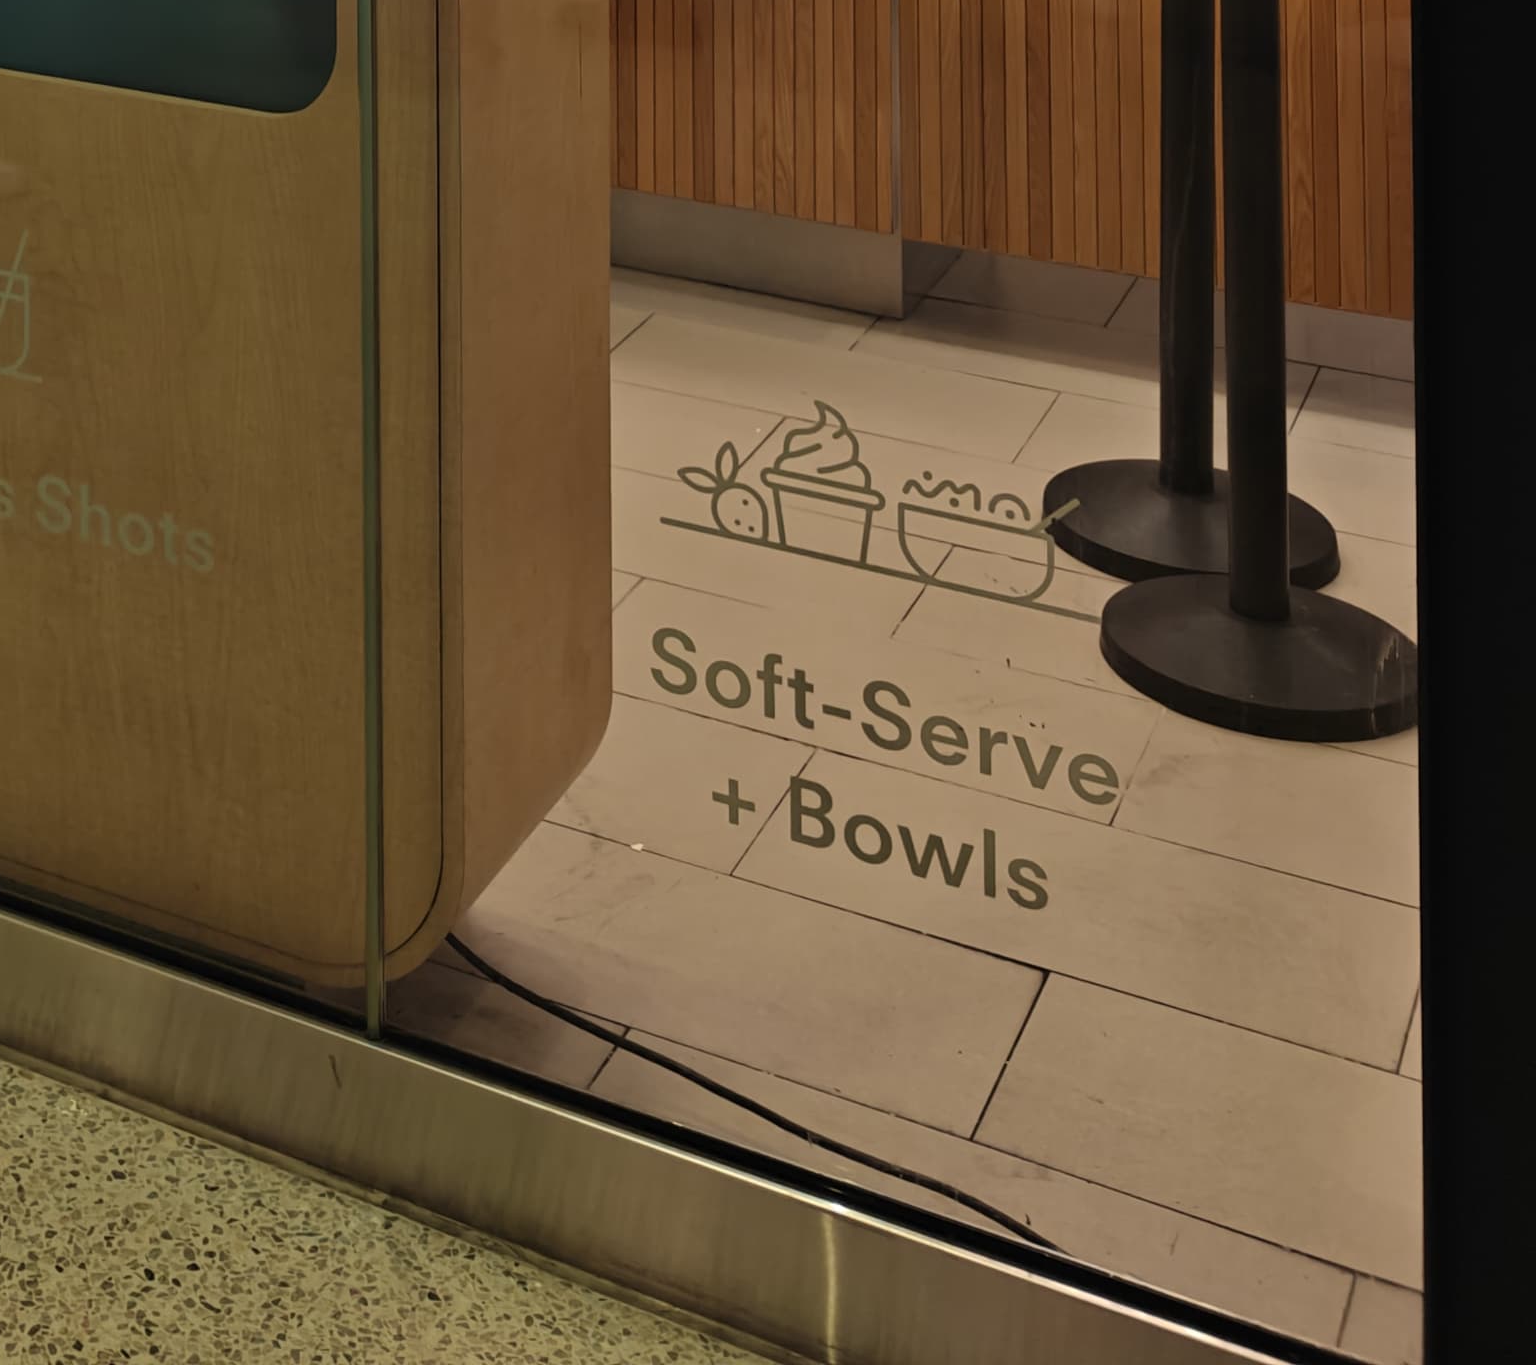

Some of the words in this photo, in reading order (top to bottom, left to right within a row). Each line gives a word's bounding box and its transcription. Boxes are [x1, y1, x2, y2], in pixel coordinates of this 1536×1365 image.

[36, 473, 216, 572] Shots
[650, 626, 1120, 806] Soft-Serve
[789, 775, 1050, 912] Bowls
